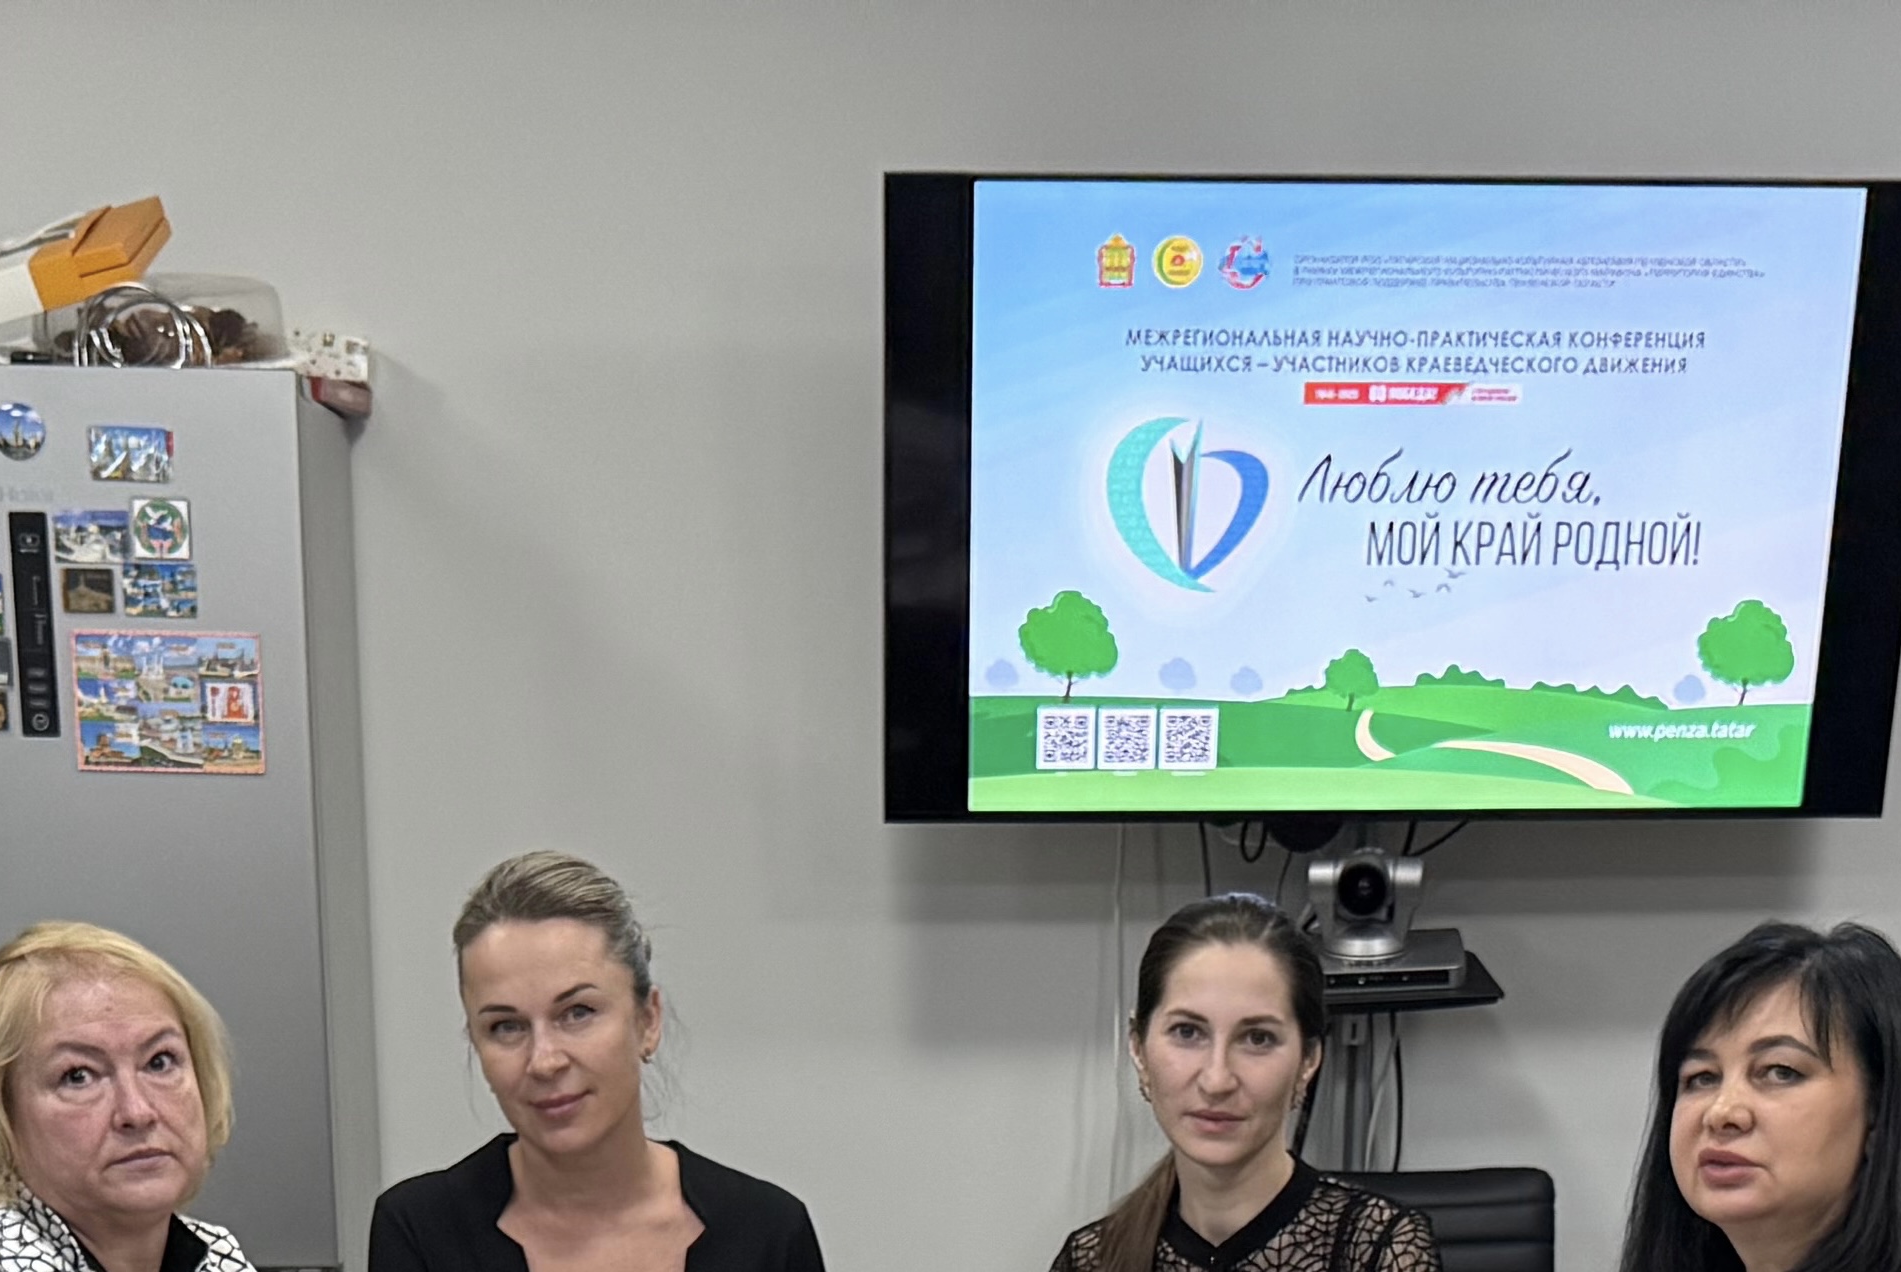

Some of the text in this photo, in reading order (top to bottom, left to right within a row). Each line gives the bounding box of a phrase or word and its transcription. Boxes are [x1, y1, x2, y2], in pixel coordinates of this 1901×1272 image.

[1125, 330, 1705, 350] МЕЖРЕГИОНАЛЬНАЯ НАУЧНО-ПРАКТИЧЕСКАЯ КОНФЕРЕНЦИЯ
[1141, 355, 1252, 373] УЧАЩИХСЯ
[1273, 355, 1398, 373] УЧАСТНИКОВ
[1406, 356, 1578, 374] КРАЕВЕДЧЕСКОГО
[1583, 357, 1688, 375] ДВИЖЕНИЯ
[1298, 446, 1457, 504] Люблю
[1365, 512, 1702, 572] МОЙ КРАЙ РОДНОЙ!
[1609, 721, 1759, 743] www.penza.tatar
